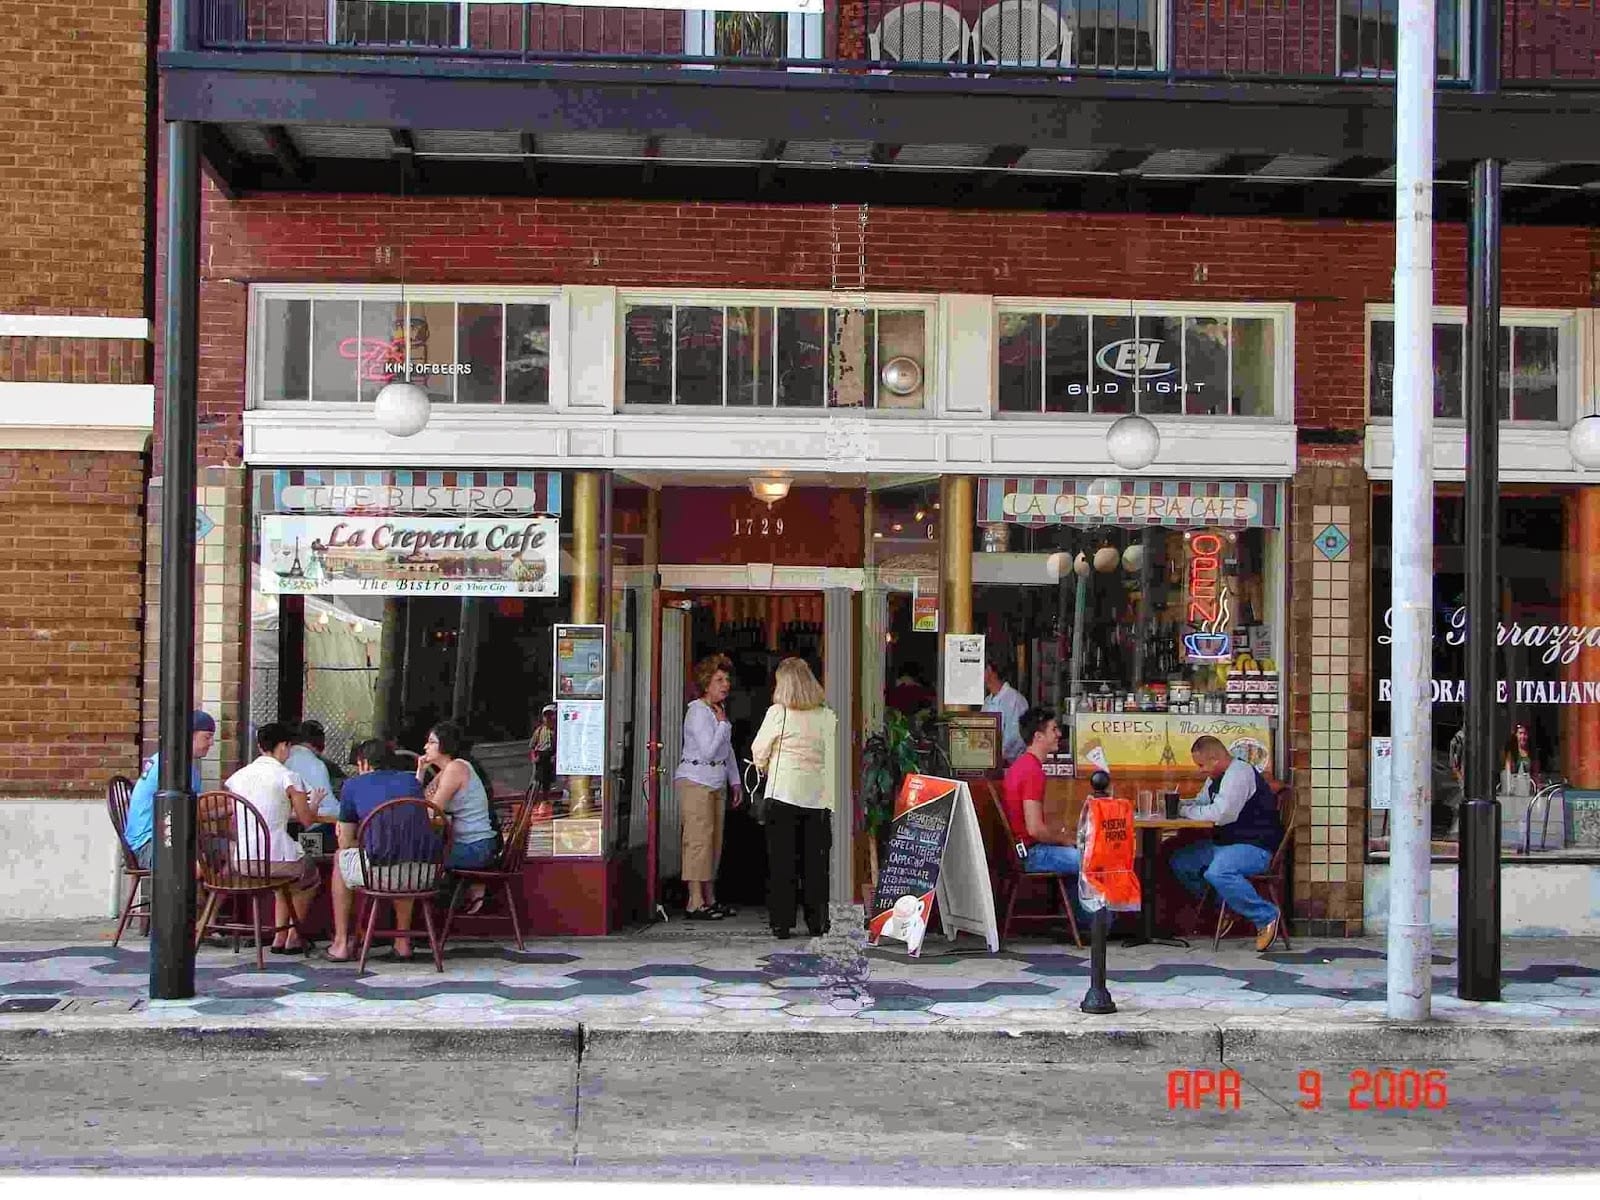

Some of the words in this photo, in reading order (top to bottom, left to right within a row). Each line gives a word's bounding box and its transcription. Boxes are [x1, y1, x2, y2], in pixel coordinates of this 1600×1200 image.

[384, 363, 414, 374] KING
[415, 363, 431, 374] OF
[432, 363, 472, 375] BEERS
[1067, 382, 1119, 395] BUD
[1132, 382, 1206, 394] LIGHT
[306, 486, 378, 507] THE
[387, 486, 514, 509] BISTRO
[1012, 494, 1043, 515] LA
[1054, 495, 1186, 516] CREPERIA
[1190, 497, 1248, 518] CAFE
[734, 518, 785, 536] 1729
[327, 523, 366, 548] La
[372, 523, 479, 556] Creperia
[485, 523, 547, 557] Cafe
[358, 577, 388, 591] The
[396, 577, 450, 591] Bistro
[1188, 534, 1222, 623] OPEN
[1091, 720, 1154, 734] CREPES
